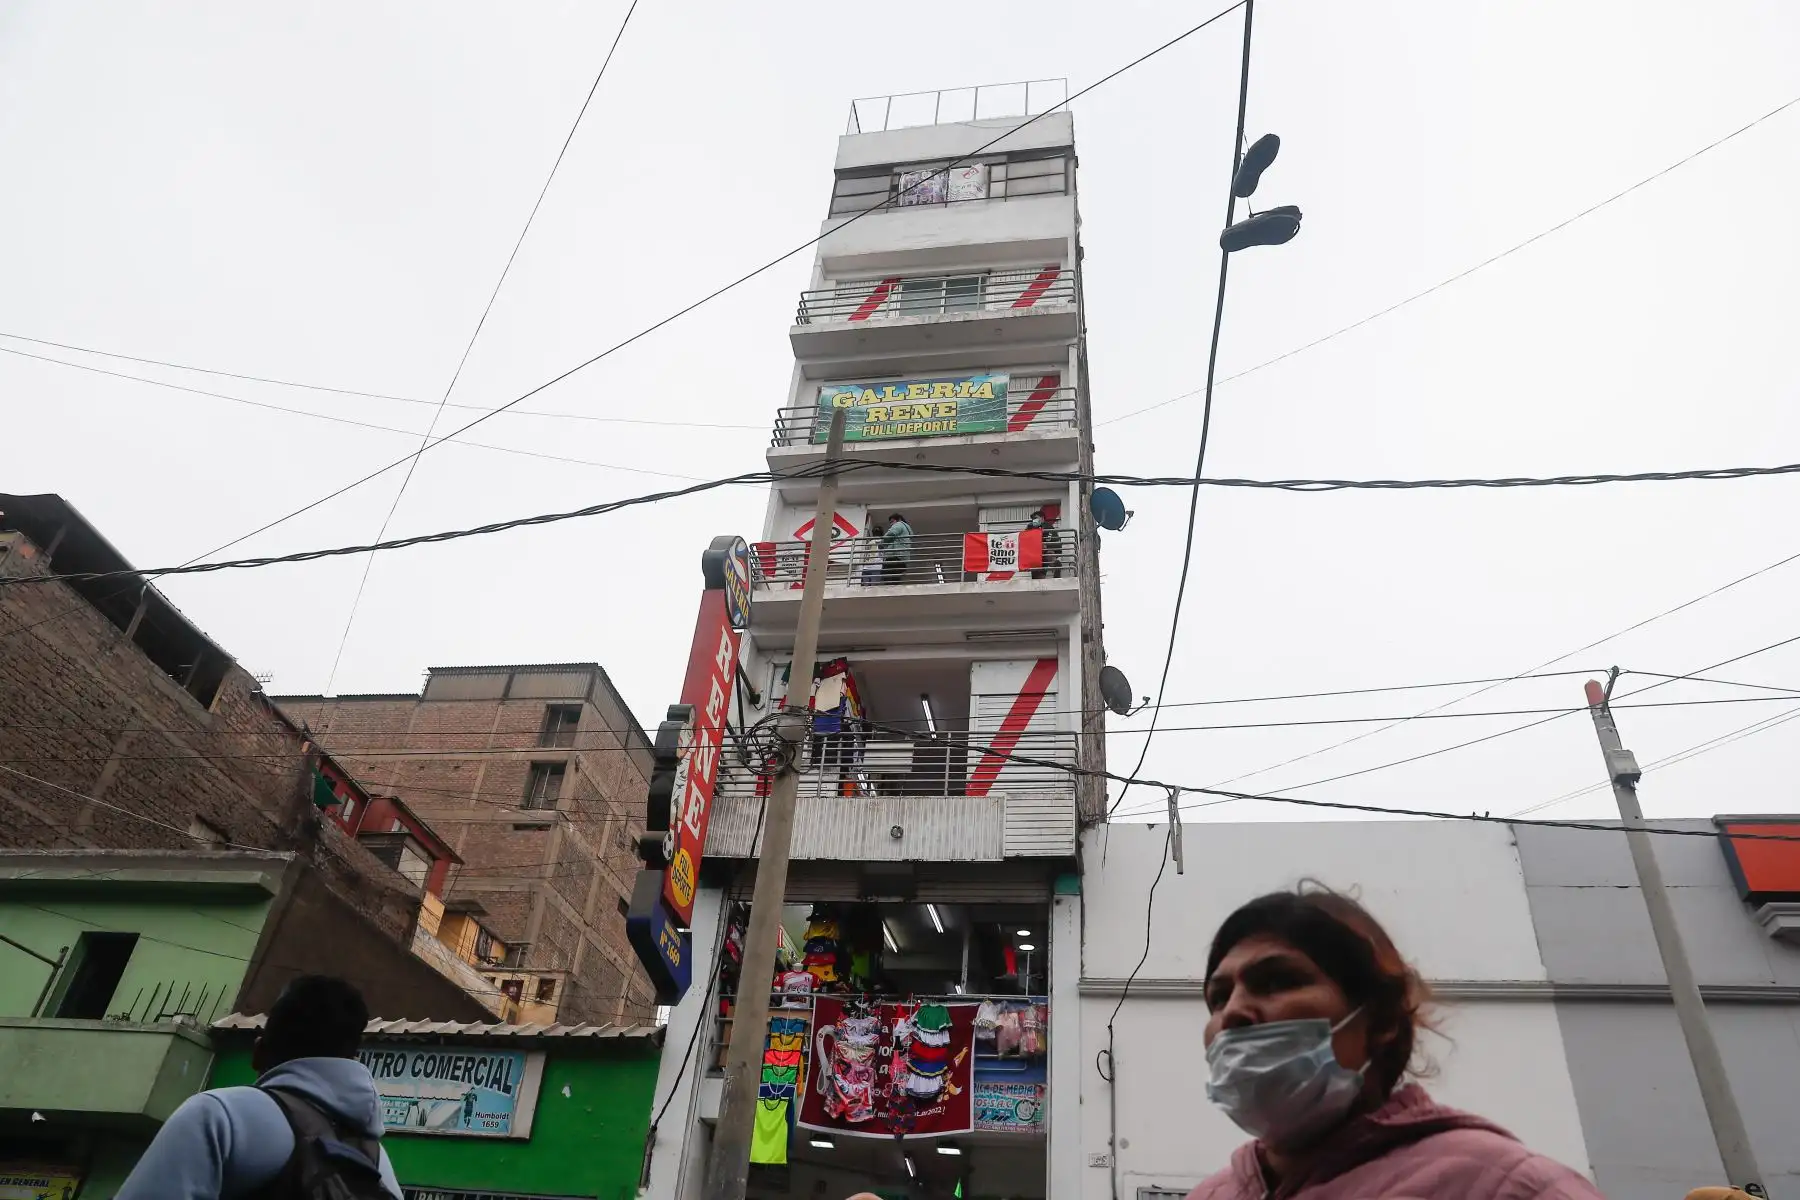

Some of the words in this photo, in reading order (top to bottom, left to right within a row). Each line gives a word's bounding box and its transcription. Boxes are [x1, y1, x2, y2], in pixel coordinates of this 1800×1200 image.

[832, 382, 995, 409] GALERIA
[866, 401, 957, 423] RENE
[862, 423, 893, 437] FULL
[896, 420, 957, 435] DEPORTE
[990, 549, 1015, 557] amo
[991, 539, 1002, 549] te
[725, 558, 749, 624] GALERIA
[684, 625, 733, 840] RENE
[680, 854, 689, 880] FULL
[672, 866, 691, 902] DEPORTE
[357, 1051, 407, 1078] NTRO
[410, 1052, 513, 1095] COMERCIAL
[475, 1111, 510, 1121] Humboldt
[481, 1120, 499, 1129] 1659
